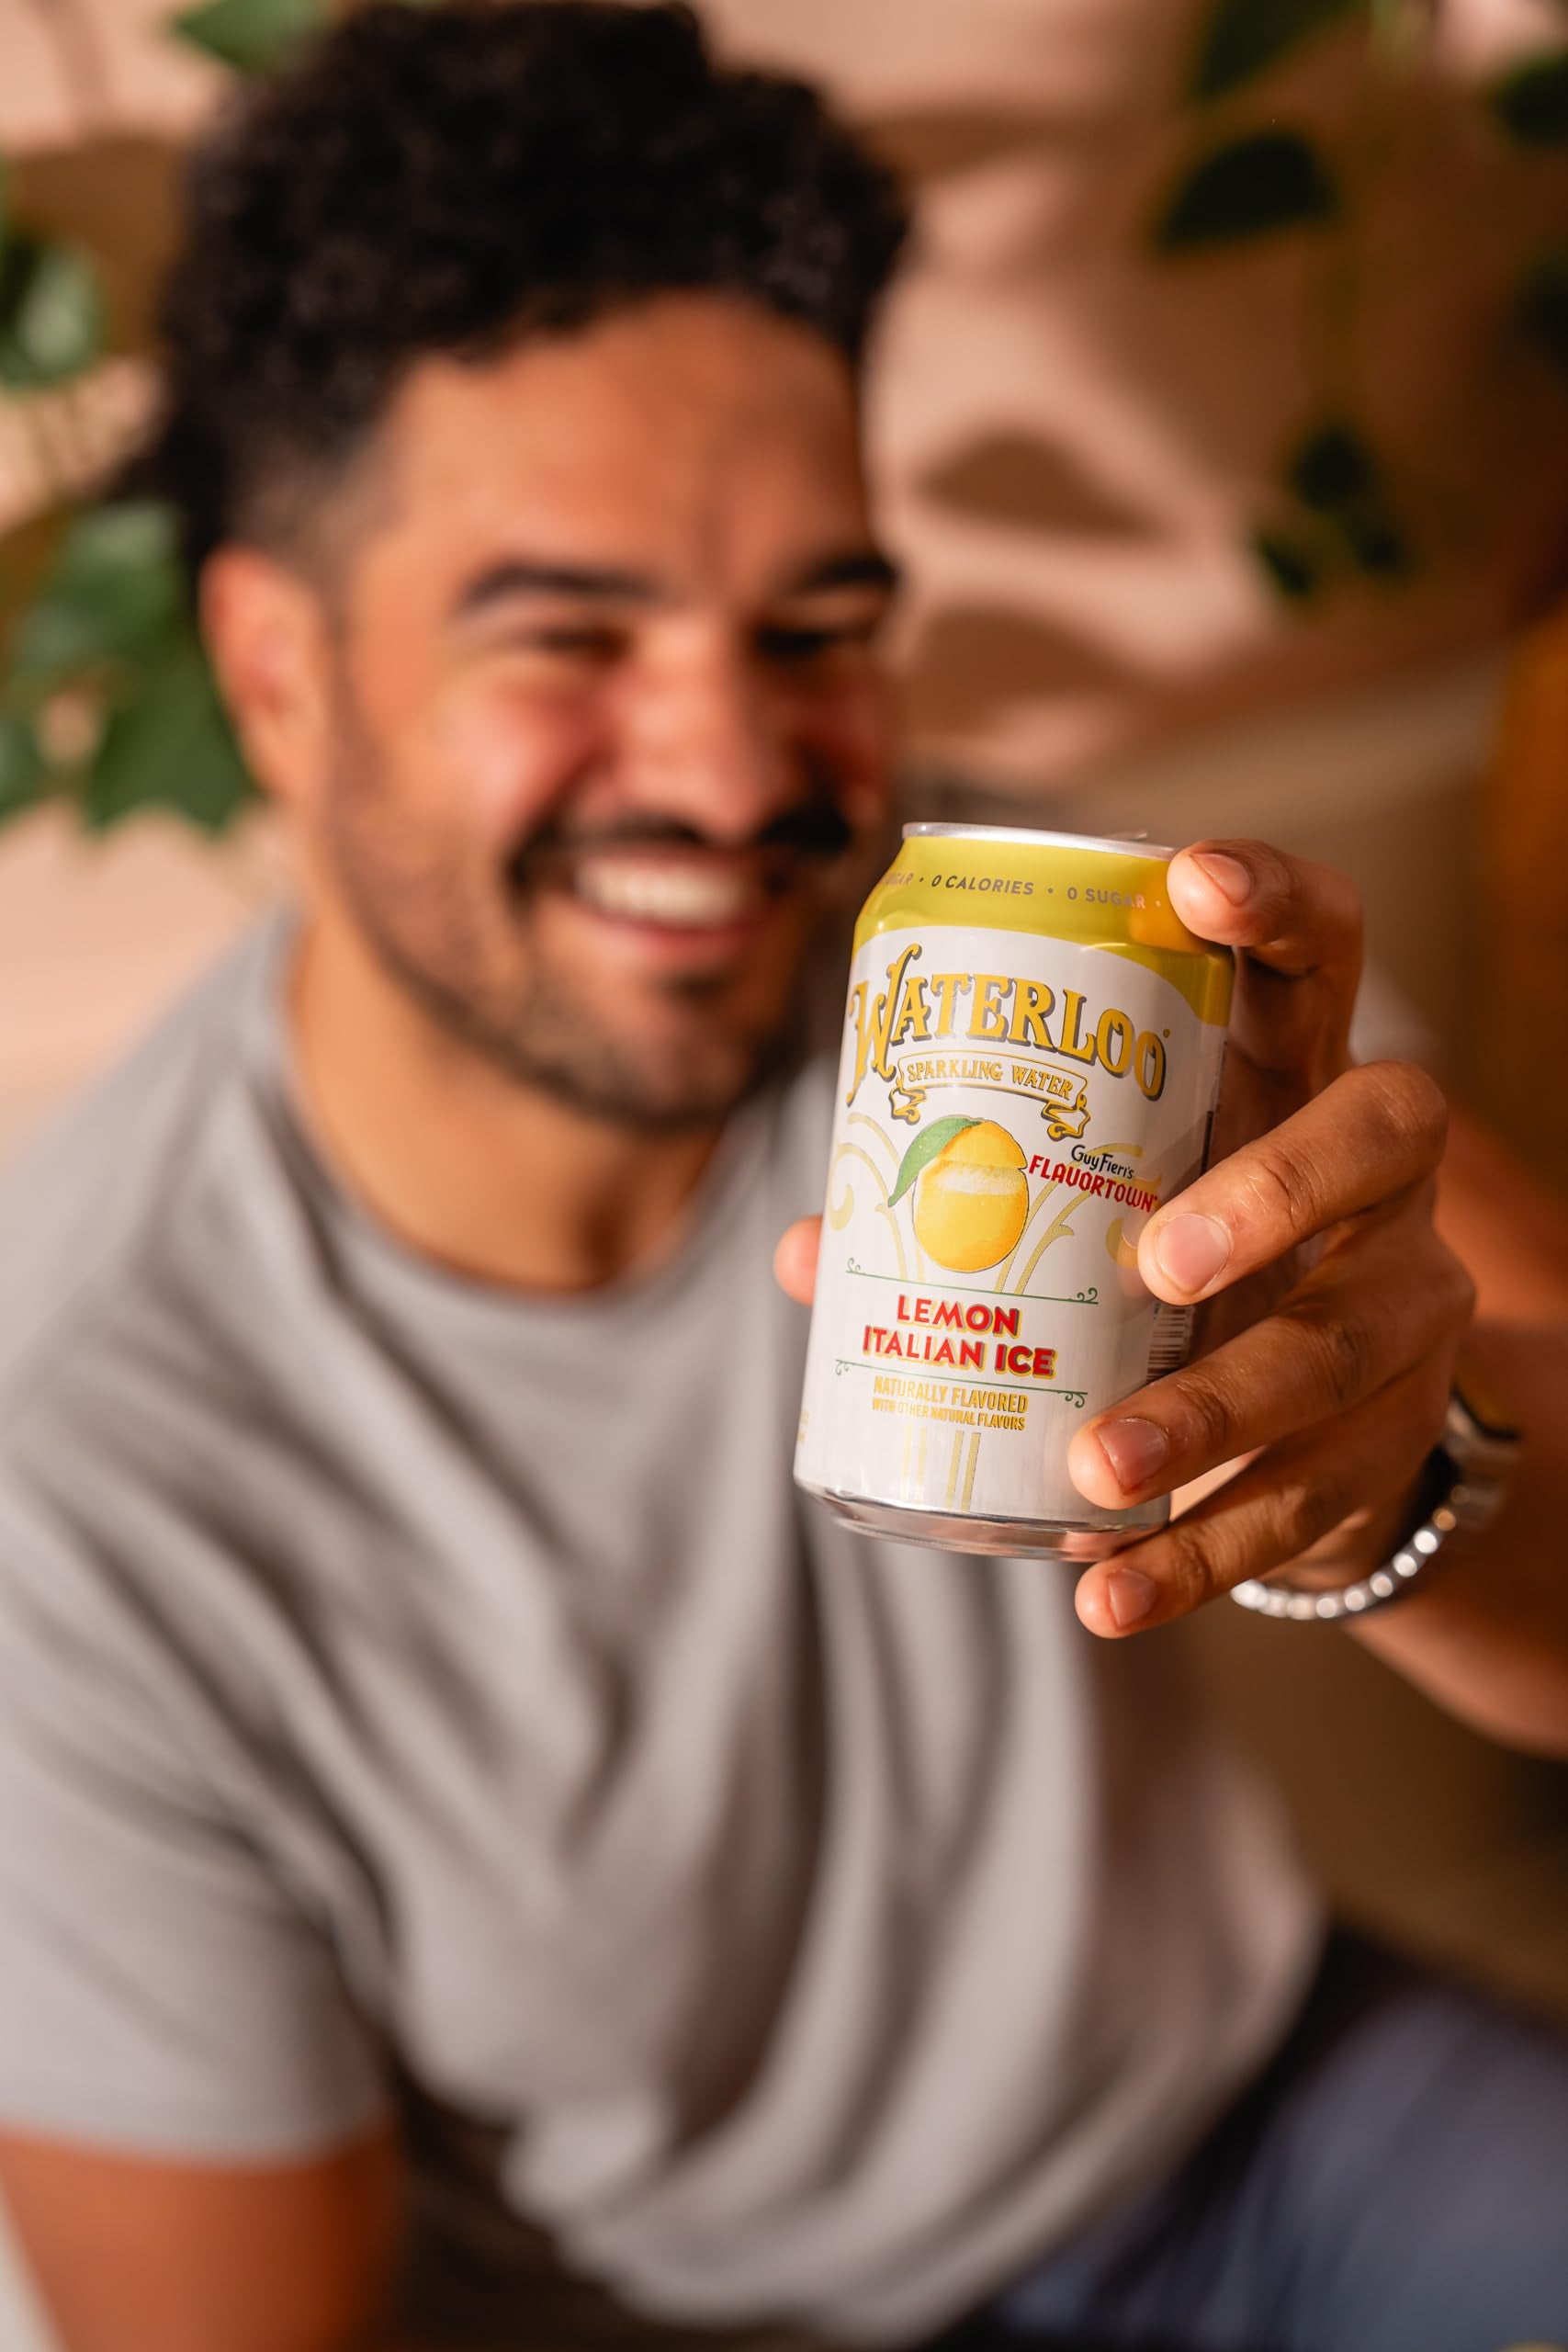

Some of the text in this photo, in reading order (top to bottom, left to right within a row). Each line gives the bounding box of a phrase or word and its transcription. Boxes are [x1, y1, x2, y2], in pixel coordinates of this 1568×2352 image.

[931, 875, 942, 888] 0
[944, 876, 1034, 896] CALORIES
[1067, 887, 1146, 910] 0 SUGAR
[847, 943, 1167, 1106] WATERLOO
[908, 1060, 1074, 1101] SPARKLING WATER
[1071, 1144, 1100, 1171] Guy
[1028, 1154, 1156, 1213] FLAVORTOWN
[897, 1295, 1021, 1338] LEMON
[863, 1325, 1057, 1378] ITALIAN ICE
[872, 1396, 1026, 1431] WITH OTHER NATURAL FLAVORS
[874, 1375, 1029, 1414] NATURALLY FLAVORED
